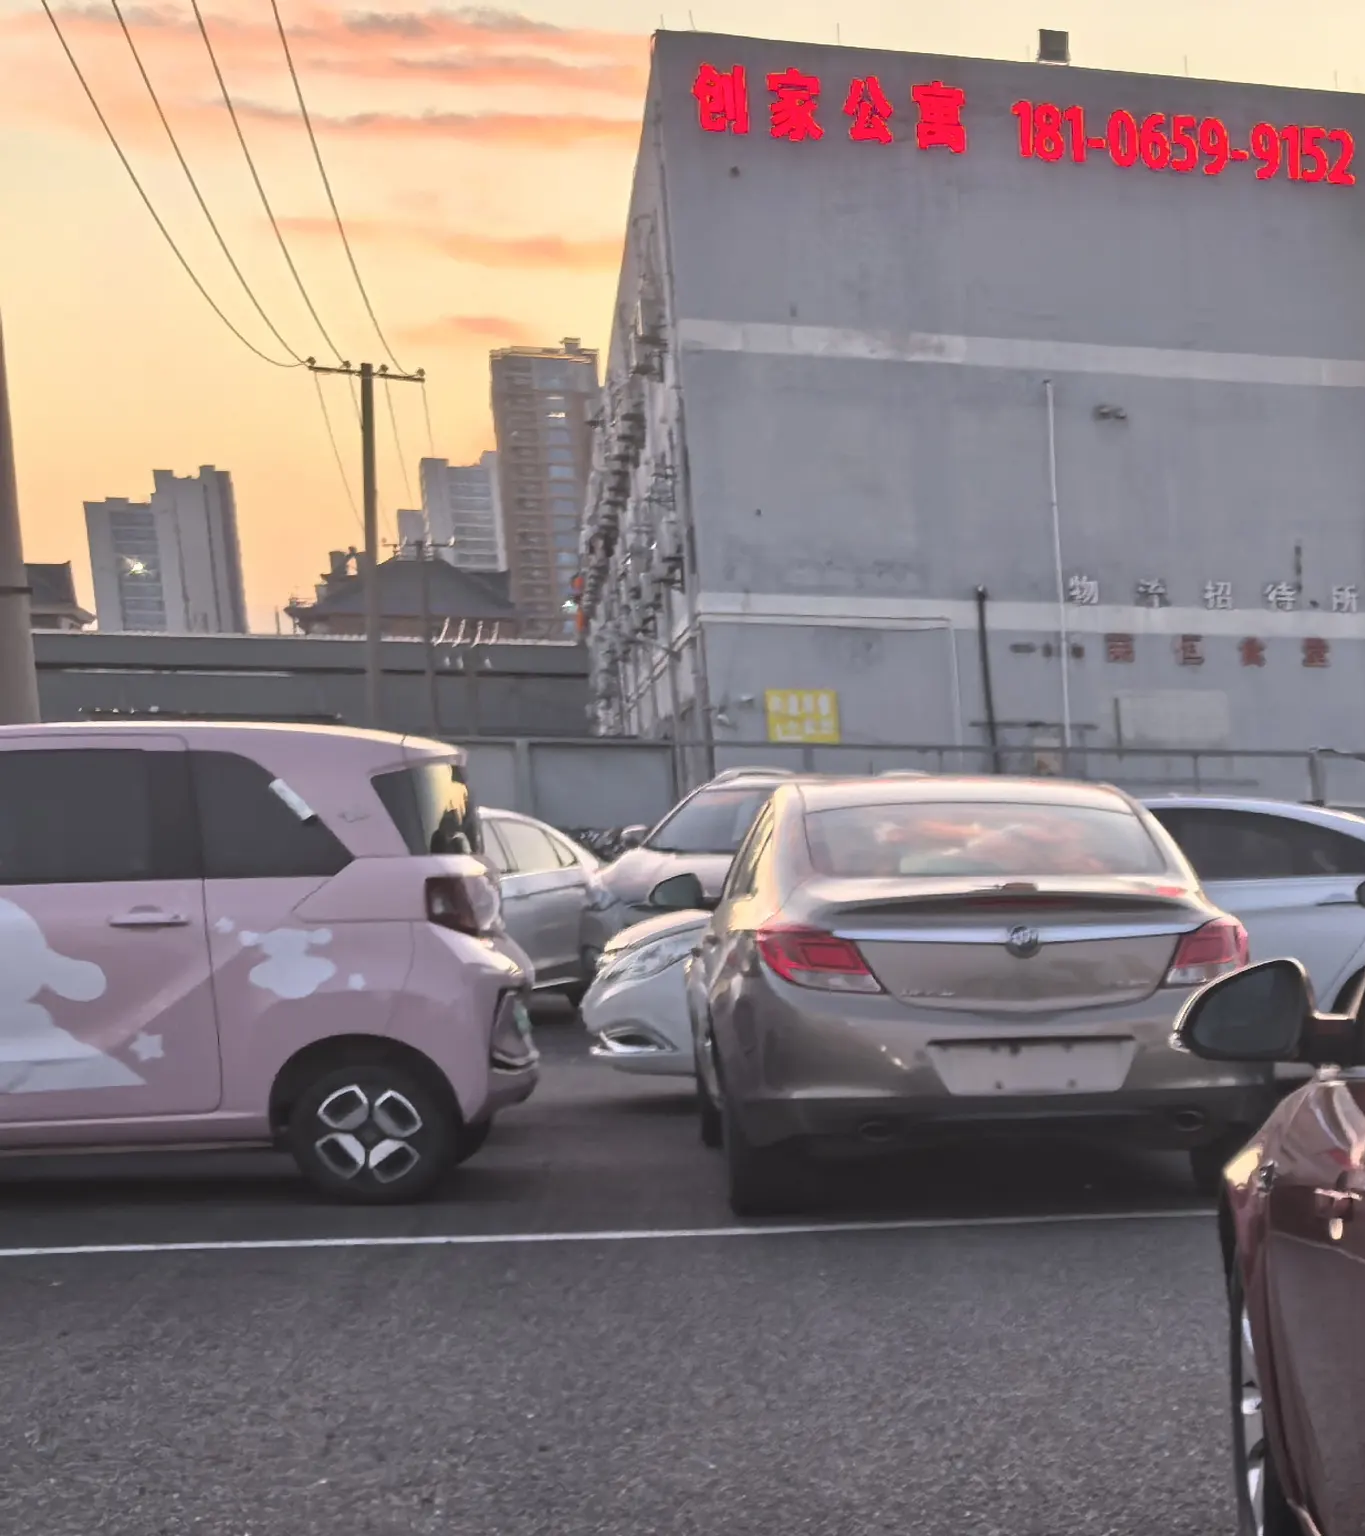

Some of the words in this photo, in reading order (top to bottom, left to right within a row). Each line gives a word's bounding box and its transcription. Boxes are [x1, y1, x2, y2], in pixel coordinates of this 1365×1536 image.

[690, 61, 967, 154] 创家公寓
[1011, 99, 1356, 185] 181-0659-9152
